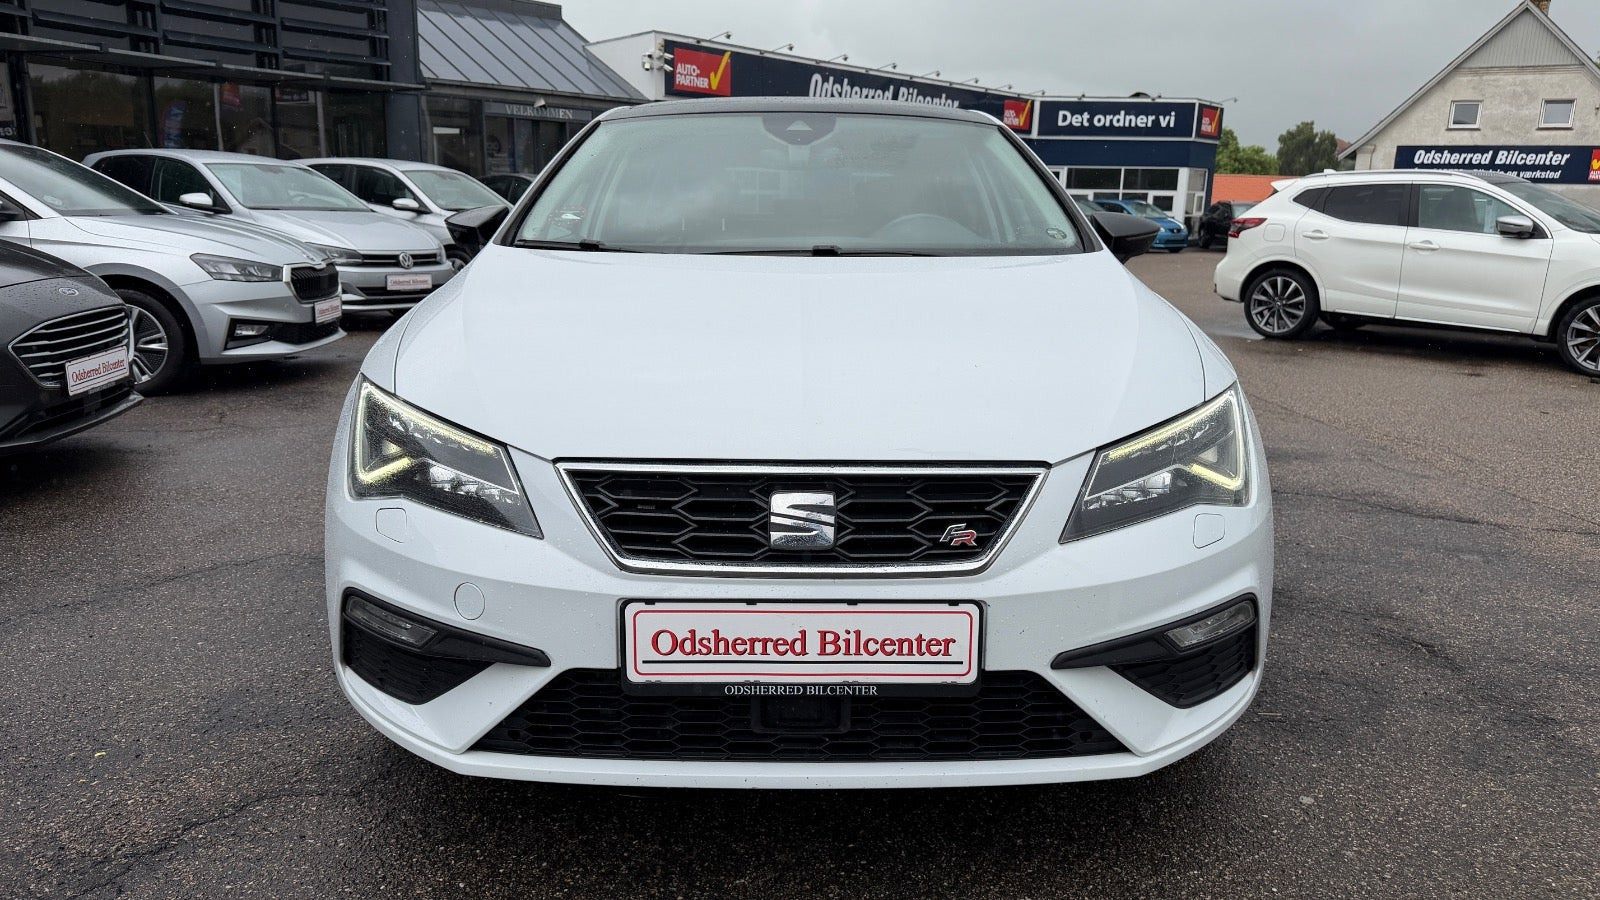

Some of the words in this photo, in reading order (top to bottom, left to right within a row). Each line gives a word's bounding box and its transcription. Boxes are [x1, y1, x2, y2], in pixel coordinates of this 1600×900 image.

[676, 63, 701, 76] AUTO-
[676, 74, 709, 89] PARTNER
[1057, 110, 1090, 127] Det
[1093, 110, 1156, 128] ordner
[1159, 111, 1176, 128] vi
[1413, 149, 1494, 165] Odsherred
[1494, 149, 1571, 166] Bilcenter
[1519, 169, 1562, 179] værksted
[72, 363, 102, 383] Odsherred
[101, 359, 125, 374] Bilcenter
[939, 523, 978, 546] FR
[651, 629, 809, 657] Odsherred
[817, 629, 957, 657] Bilcenter
[724, 685, 803, 697] ODSHERRED
[806, 685, 879, 697] BILCENTER
